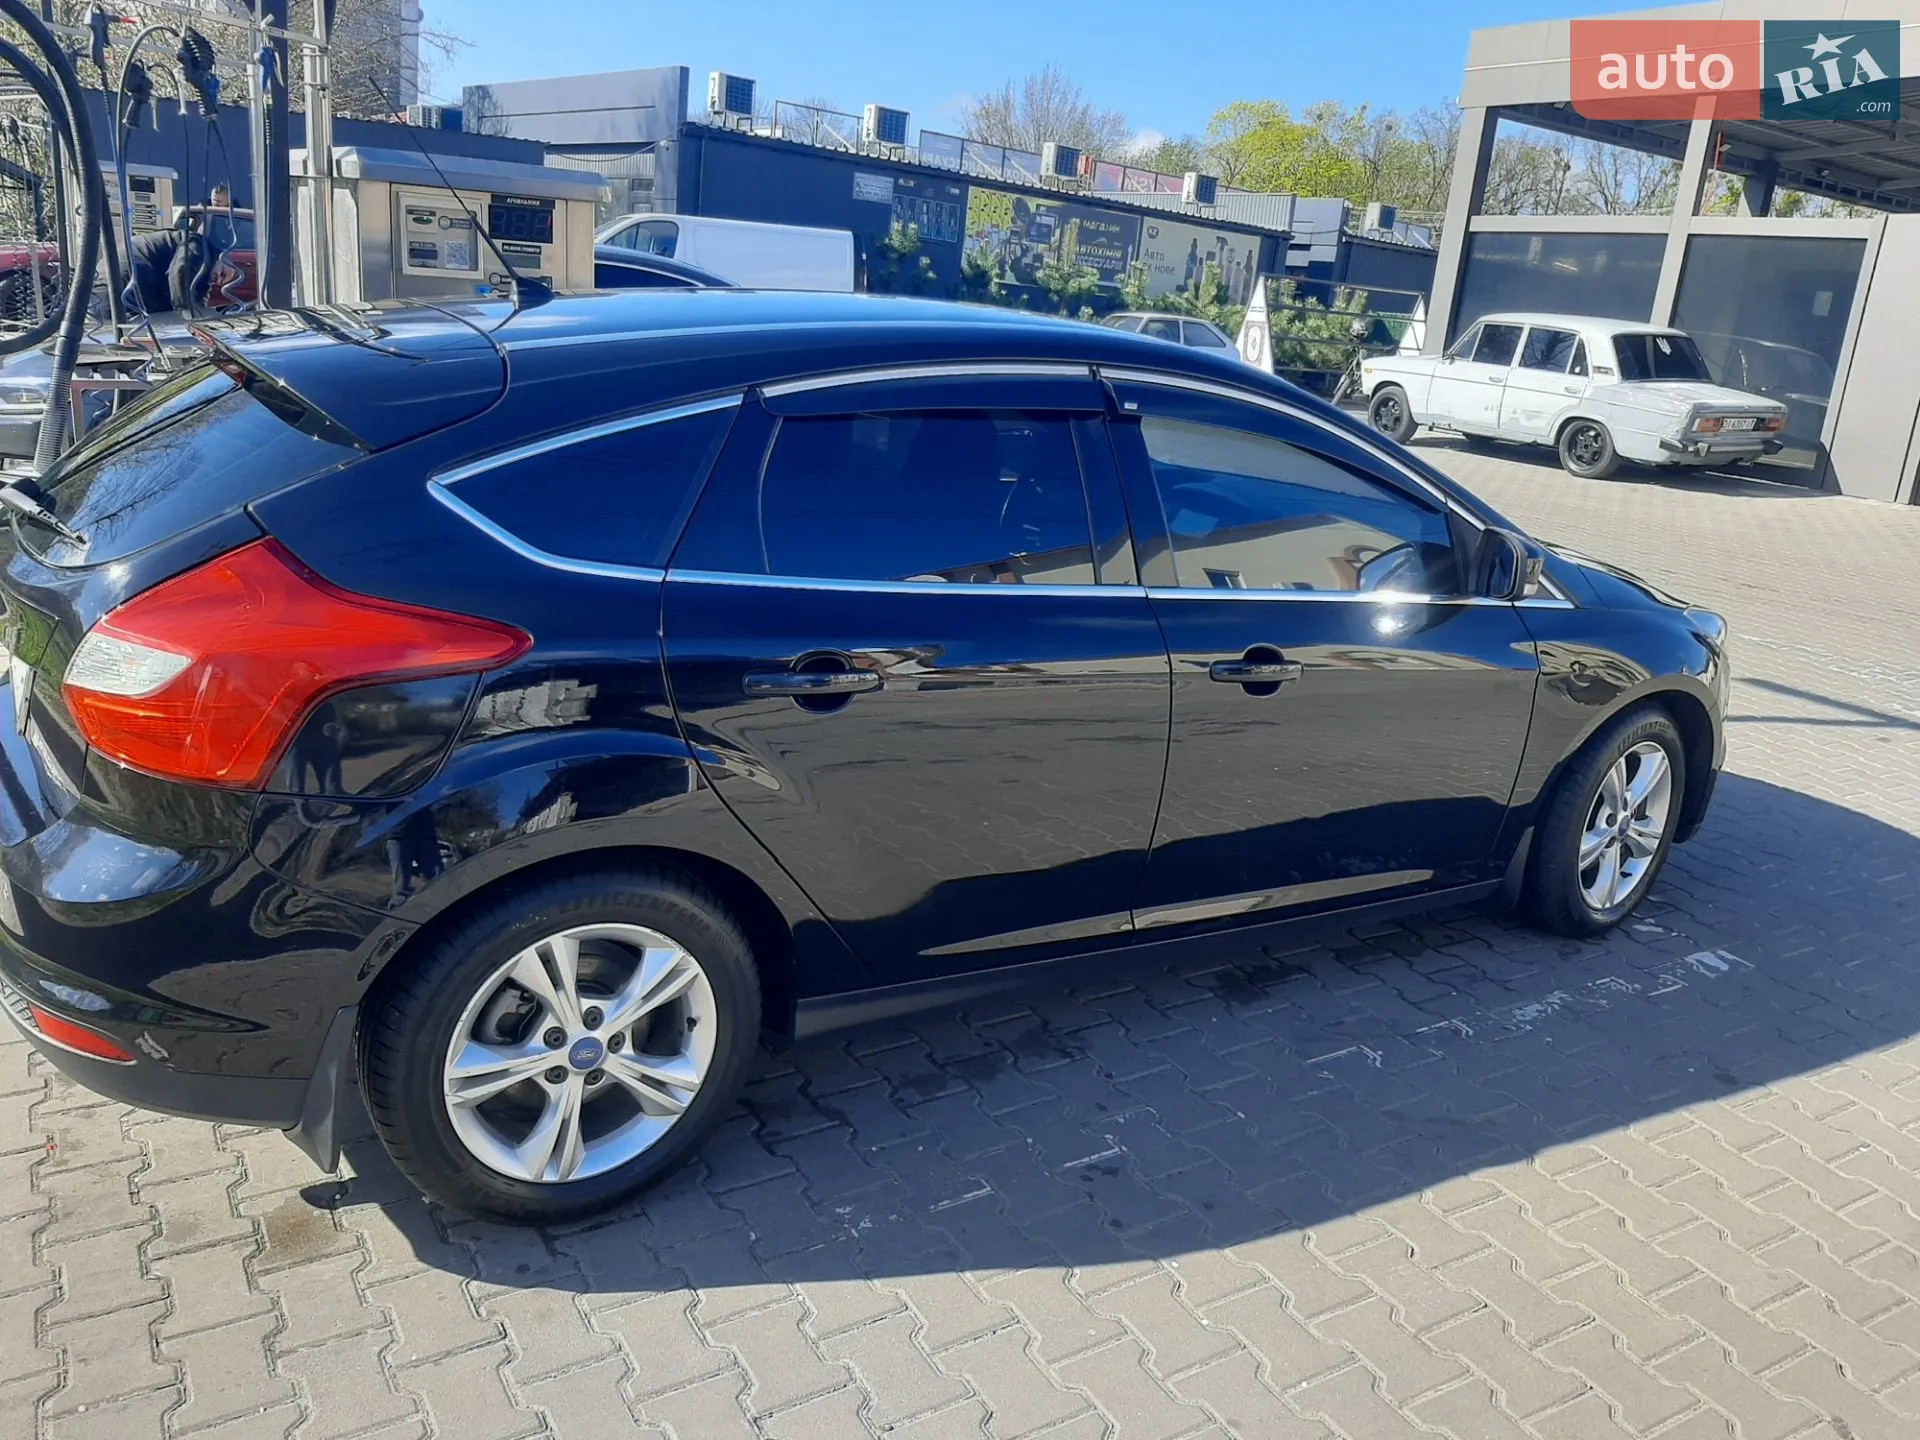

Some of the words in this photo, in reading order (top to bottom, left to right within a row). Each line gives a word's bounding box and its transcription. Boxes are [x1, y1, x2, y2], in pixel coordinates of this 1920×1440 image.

[1144, 248, 1165, 261] Авто
[1074, 254, 1123, 271] КСЕСУАРИ
[576, 1048, 597, 1061] Ford
